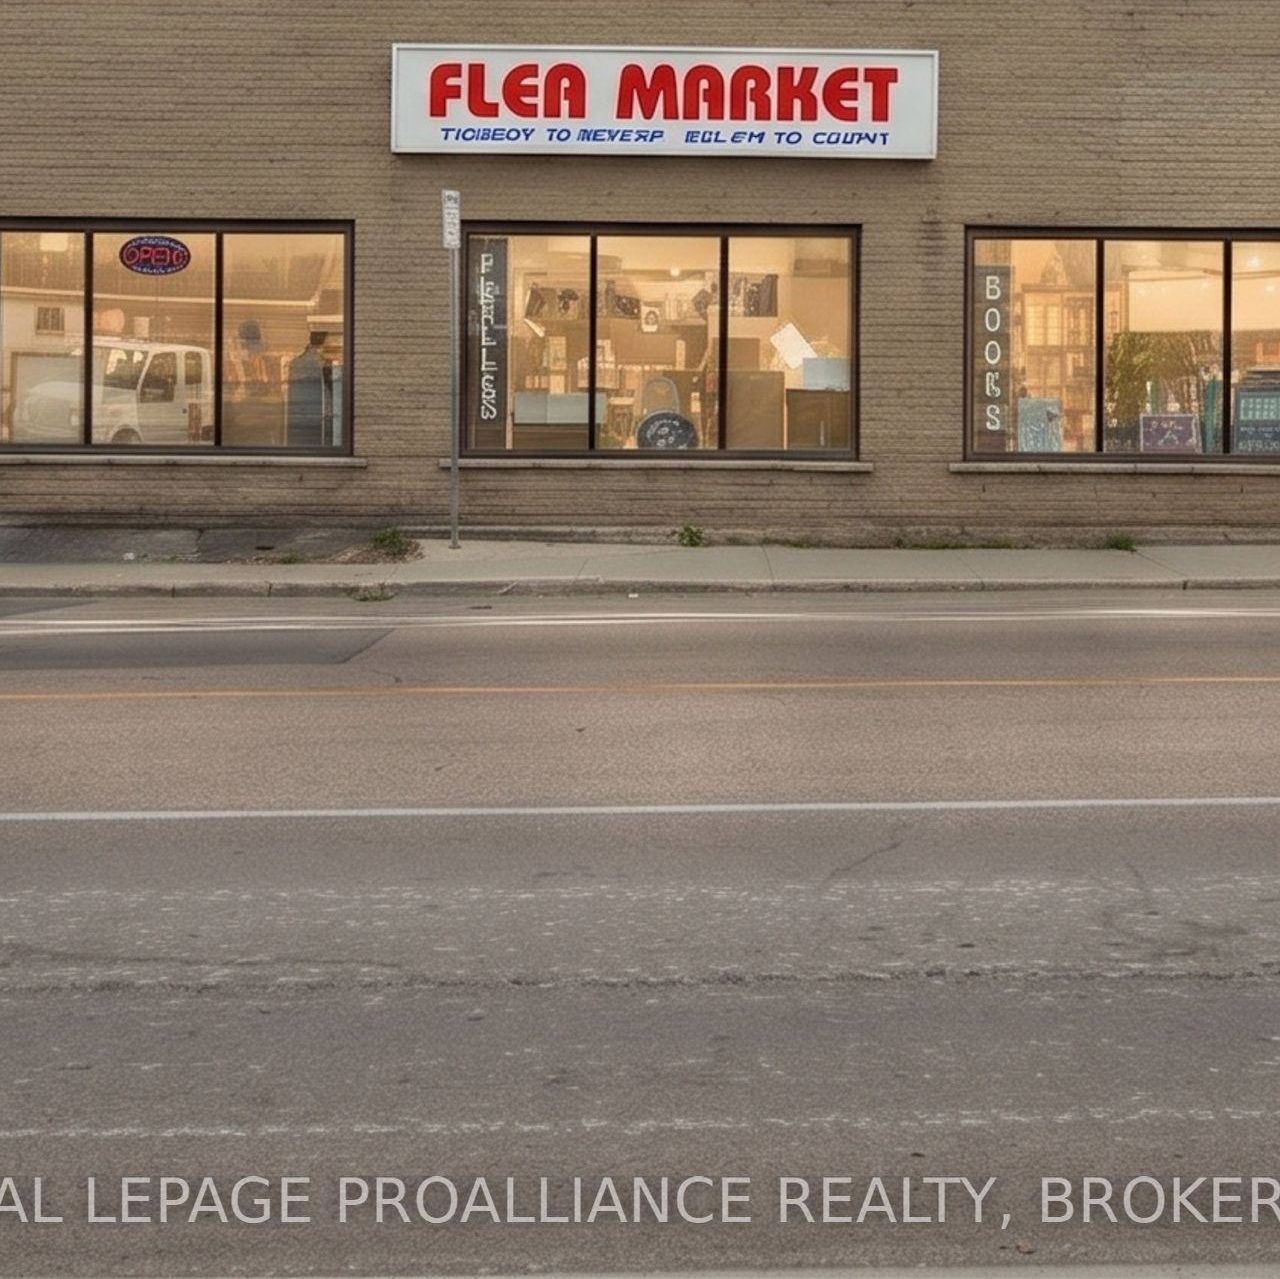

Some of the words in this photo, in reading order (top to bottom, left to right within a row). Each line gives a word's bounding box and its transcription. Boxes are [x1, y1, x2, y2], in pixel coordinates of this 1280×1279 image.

[429, 62, 586, 119] FLEA
[615, 62, 899, 123] MARKET
[546, 128, 571, 142] TO
[774, 131, 803, 145] TO
